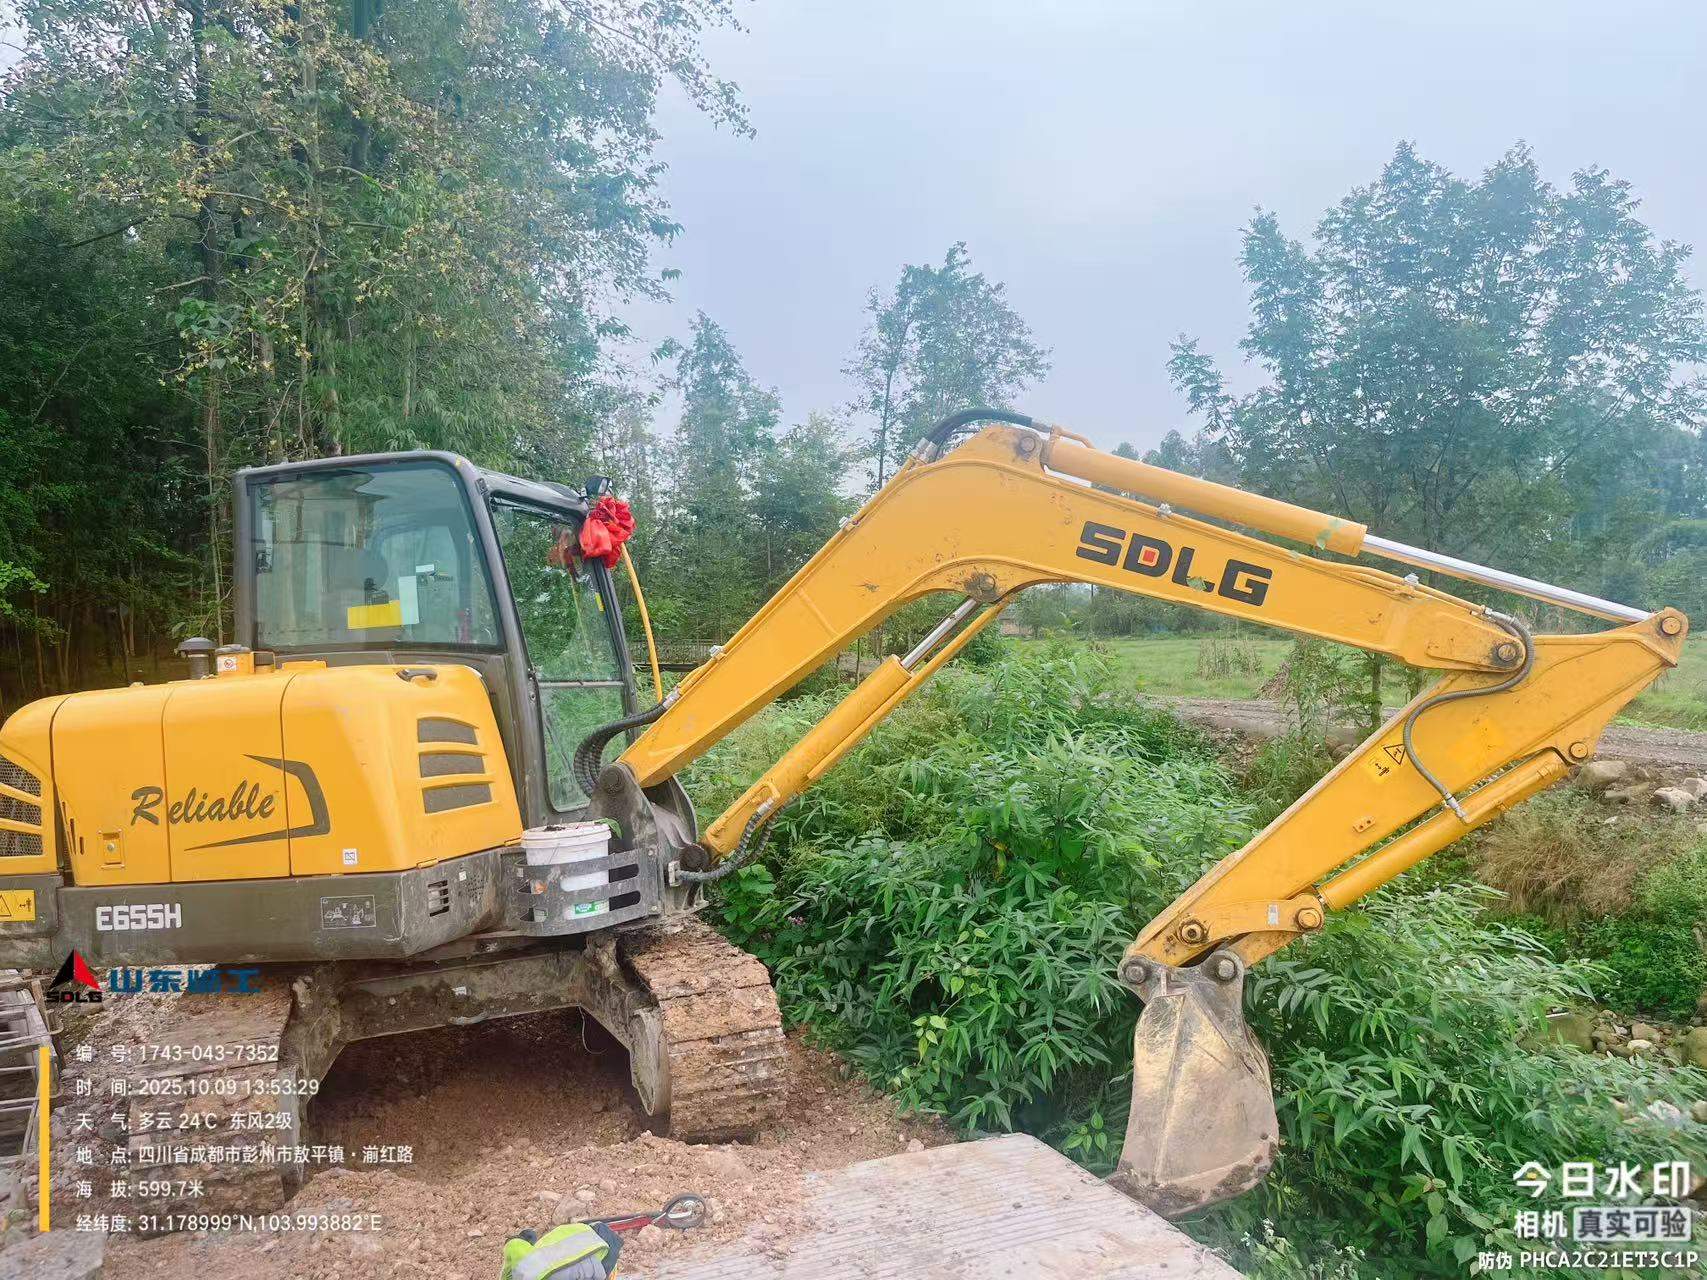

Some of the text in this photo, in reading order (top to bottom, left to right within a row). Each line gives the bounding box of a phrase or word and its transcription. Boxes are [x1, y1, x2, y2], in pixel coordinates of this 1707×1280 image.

[1076, 521, 1273, 606] SDLG
[131, 780, 276, 826] Reliable
[96, 902, 182, 931] E655H
